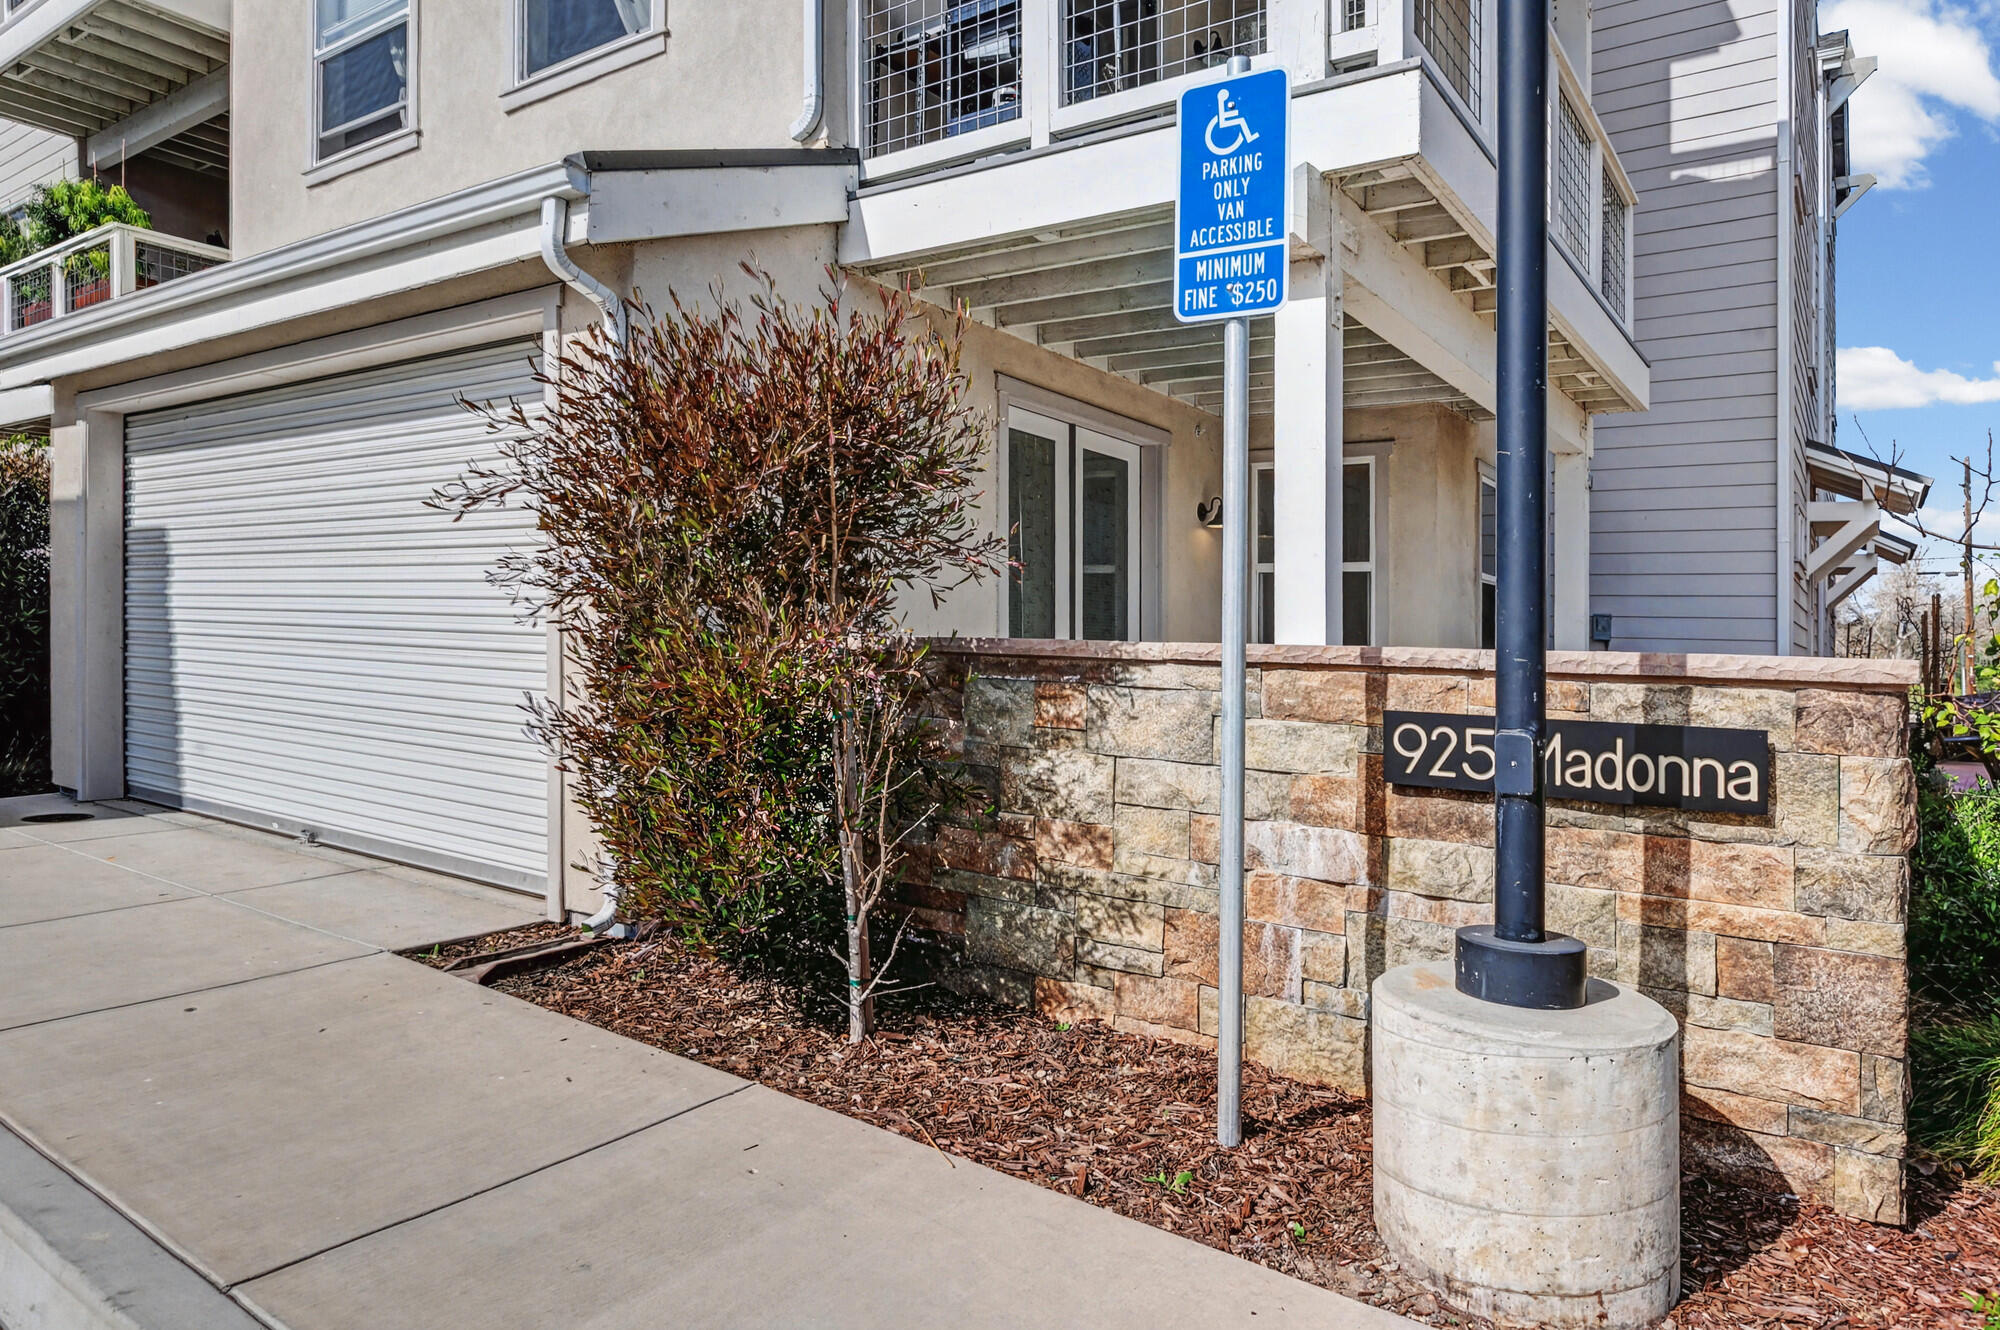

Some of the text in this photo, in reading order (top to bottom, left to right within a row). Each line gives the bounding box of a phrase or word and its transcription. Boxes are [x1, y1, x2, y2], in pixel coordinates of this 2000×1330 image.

[1202, 152, 1262, 180] PARKING
[1213, 177, 1250, 200] ONLY
[1217, 200, 1244, 221] VAN
[1190, 218, 1273, 248] ACCESSIBLE
[1196, 252, 1265, 282] MINIMUM
[1184, 278, 1277, 311] FINE $250
[1392, 722, 1496, 781] 925
